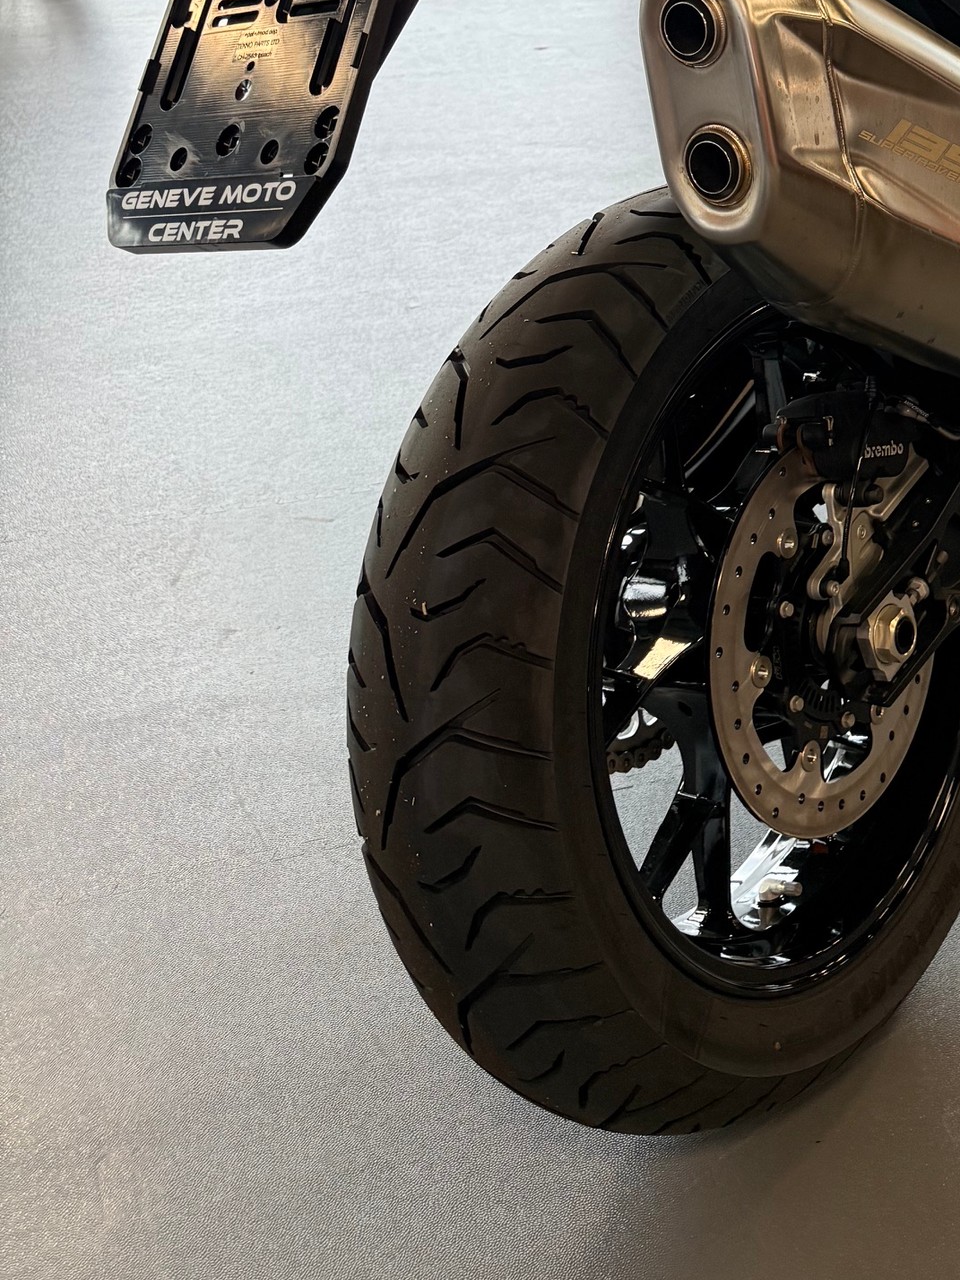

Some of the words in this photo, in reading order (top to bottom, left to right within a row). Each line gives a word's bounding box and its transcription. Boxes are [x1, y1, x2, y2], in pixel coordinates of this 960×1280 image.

[121, 186, 217, 210] GENEVE
[219, 180, 296, 205] MOTO
[148, 219, 244, 242] CENTER
[864, 440, 904, 459] brembo
